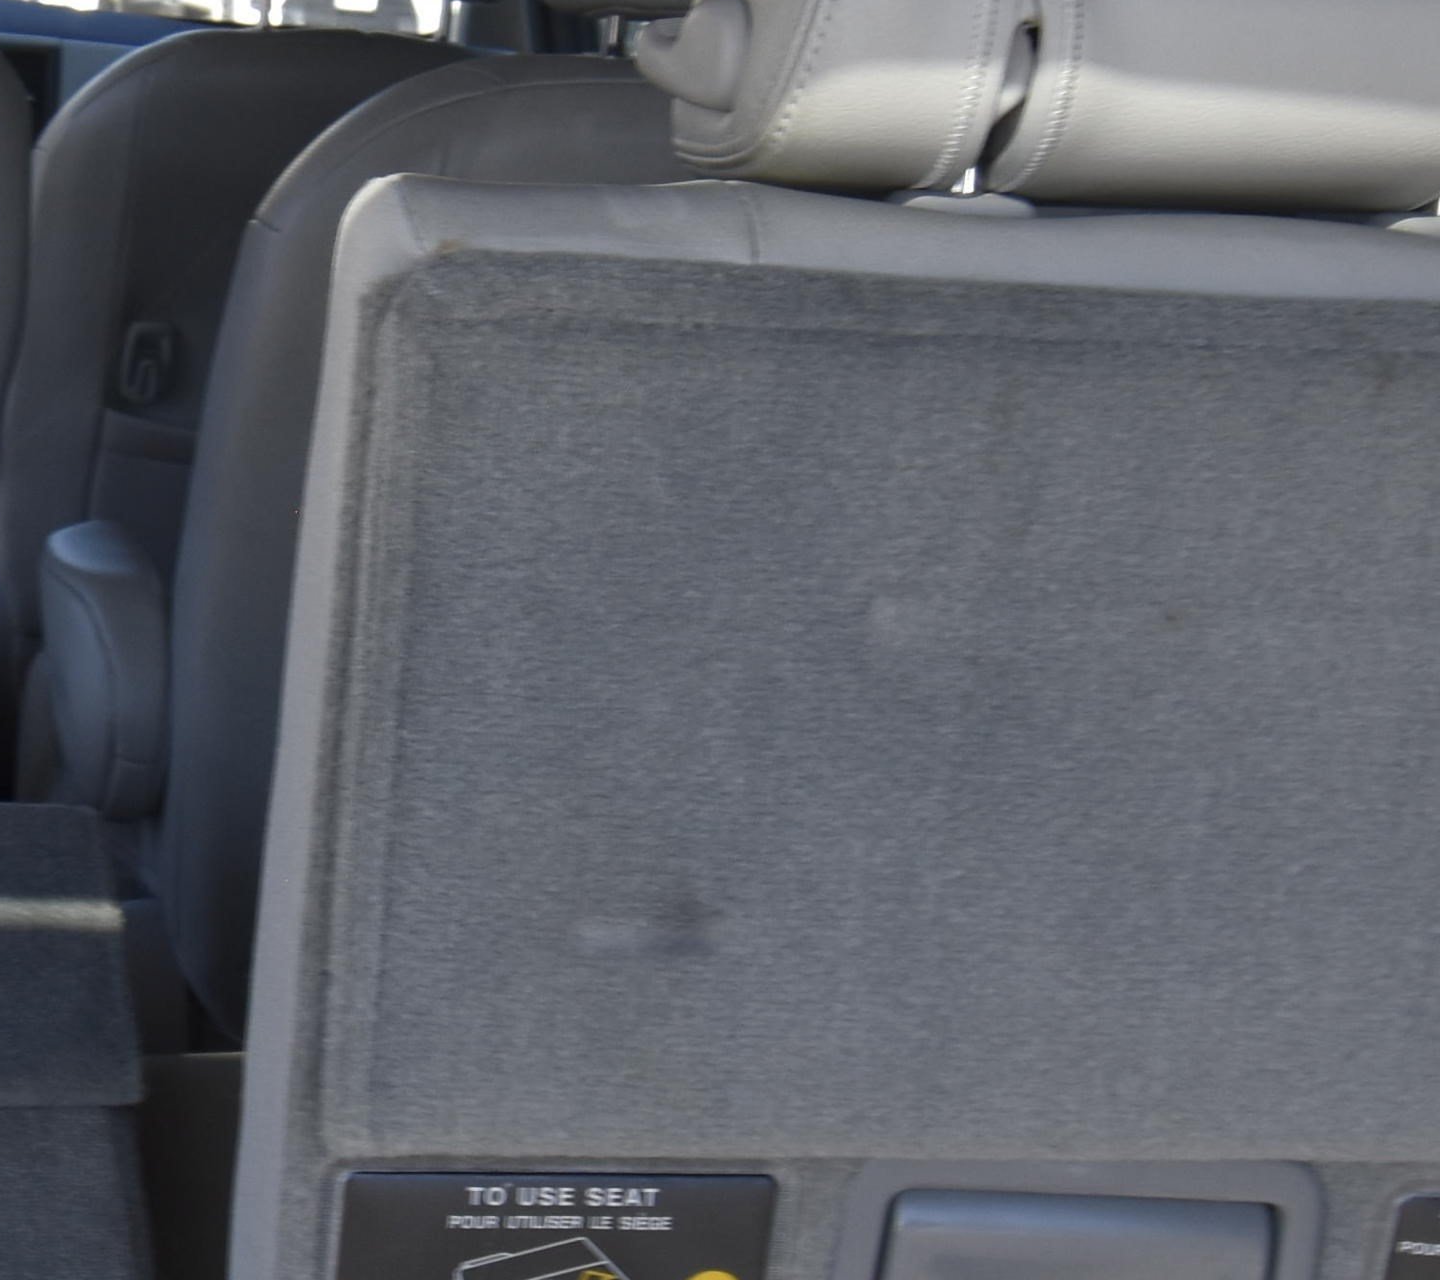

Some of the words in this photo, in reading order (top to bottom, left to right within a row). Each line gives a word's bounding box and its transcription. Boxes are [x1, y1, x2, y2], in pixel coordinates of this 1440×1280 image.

[466, 1186, 507, 1207] TO
[515, 1186, 576, 1207] USE
[584, 1187, 661, 1207] SEAT
[446, 1215, 500, 1229] POUR
[504, 1215, 585, 1229] UTILISER
[588, 1216, 614, 1230] LE
